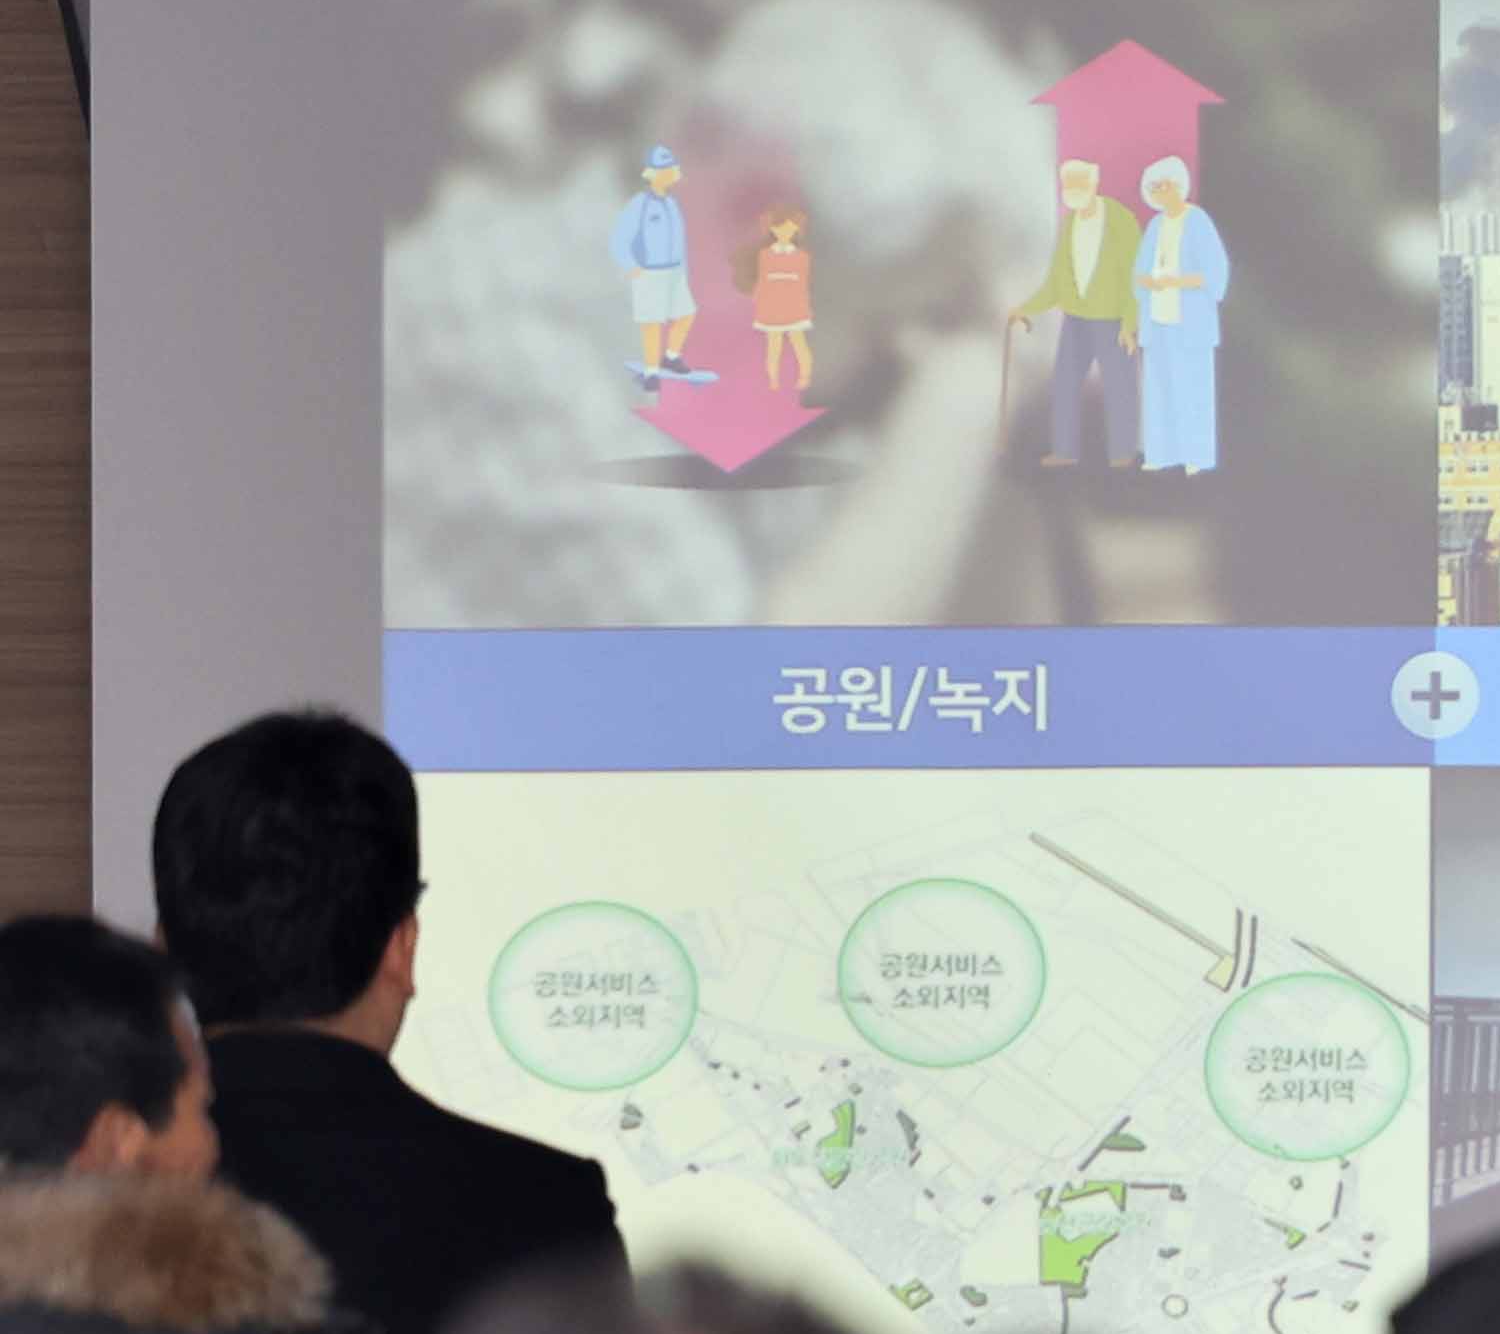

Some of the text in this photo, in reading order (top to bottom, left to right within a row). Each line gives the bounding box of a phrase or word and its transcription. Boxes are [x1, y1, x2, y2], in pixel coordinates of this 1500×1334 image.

[772, 664, 1048, 734] 공원/녹지
[878, 952, 1004, 980] 공원서비스
[533, 970, 660, 999] 공원서비스
[891, 983, 991, 1011] 소외지역
[546, 1003, 647, 1031] 소외지역
[1245, 1046, 1369, 1074] 공원서비스
[1256, 1078, 1355, 1104] 소외지역
